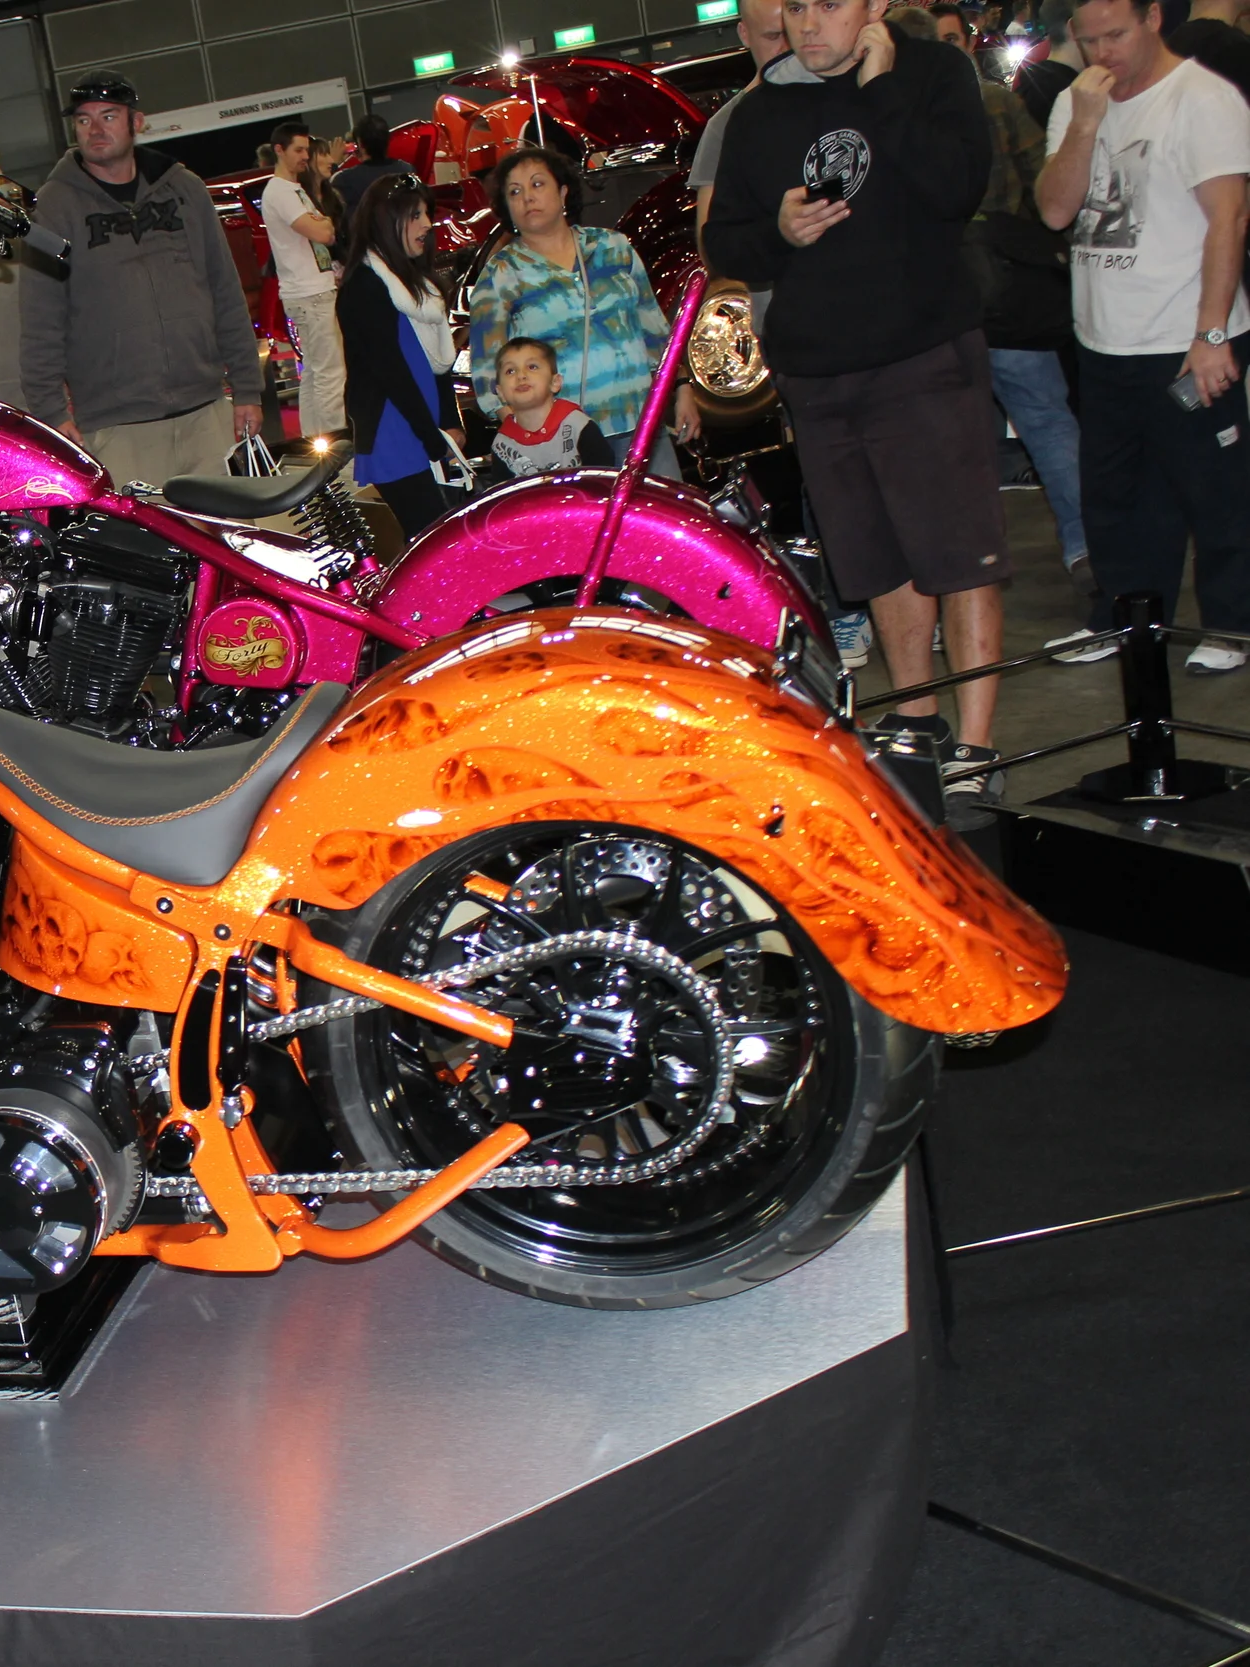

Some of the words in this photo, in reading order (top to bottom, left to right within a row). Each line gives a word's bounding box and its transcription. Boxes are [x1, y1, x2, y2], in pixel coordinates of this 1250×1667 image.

[218, 102, 260, 119] SHANNONS
[261, 95, 305, 112] INSURANCE
[212, 641, 268, 662] Forty
